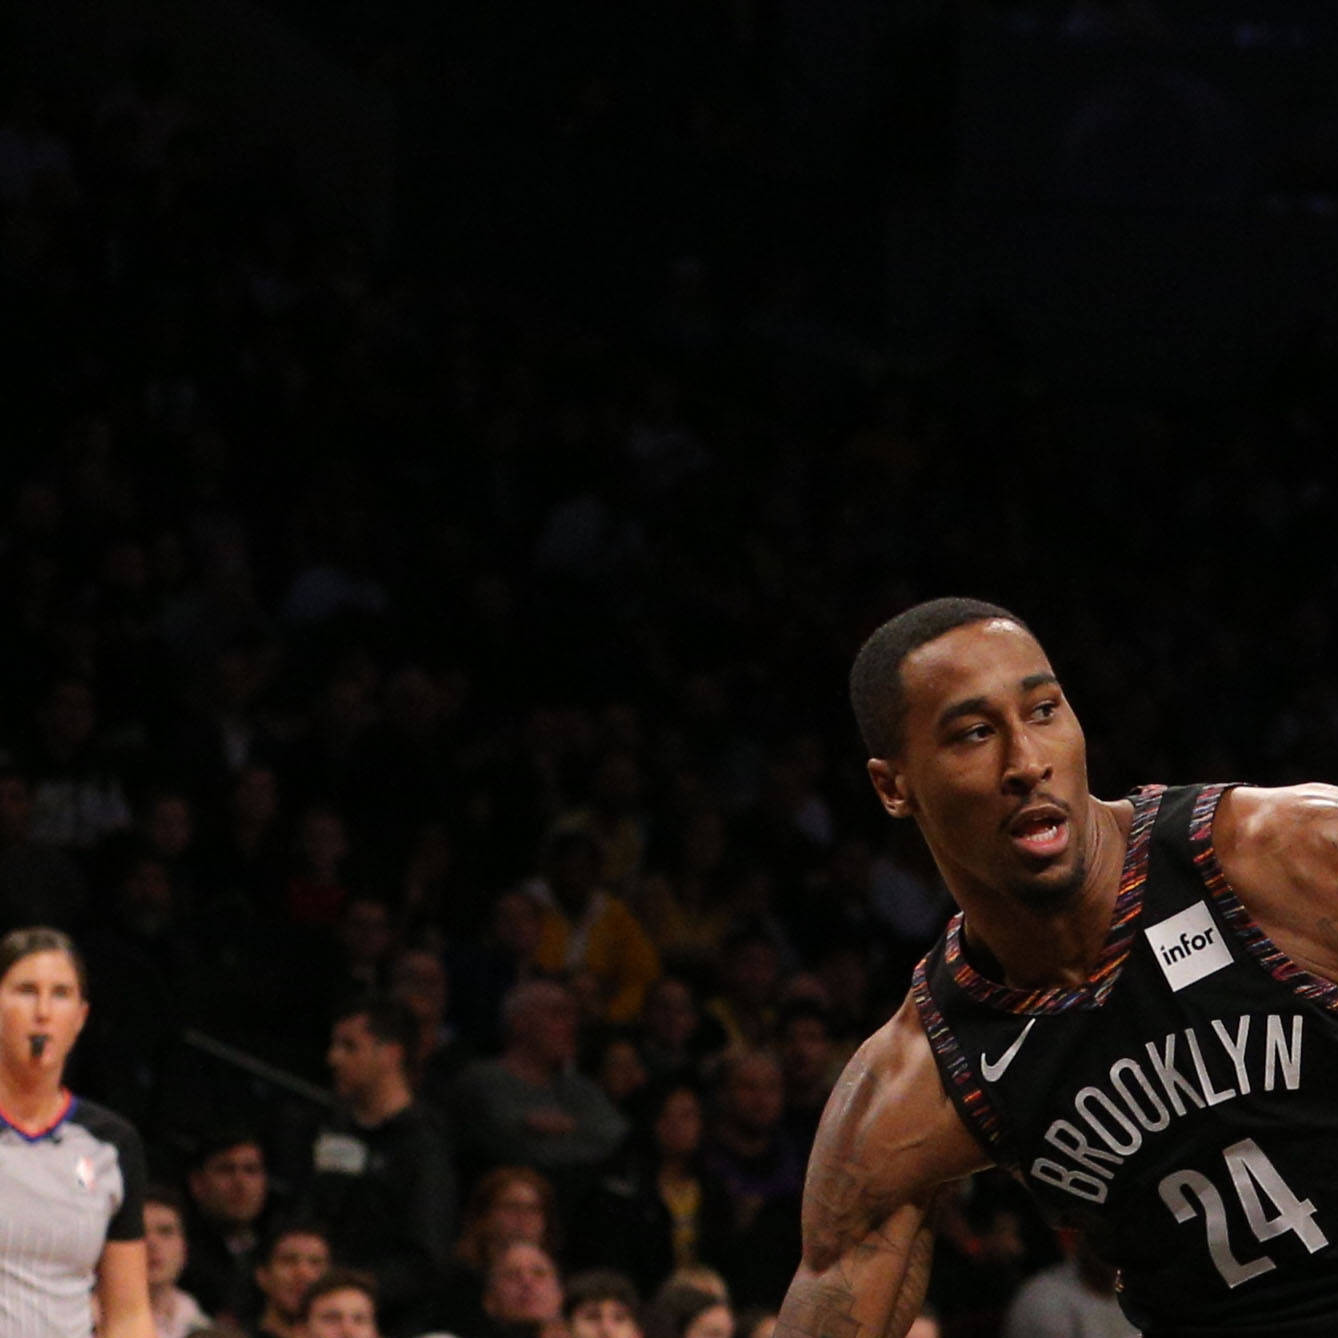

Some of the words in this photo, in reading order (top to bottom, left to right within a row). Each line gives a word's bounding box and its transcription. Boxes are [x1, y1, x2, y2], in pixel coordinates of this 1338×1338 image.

[1159, 926, 1217, 967] infor
[1031, 1014, 1304, 1204] BROOKLYN
[1158, 1138, 1330, 1289] 24
